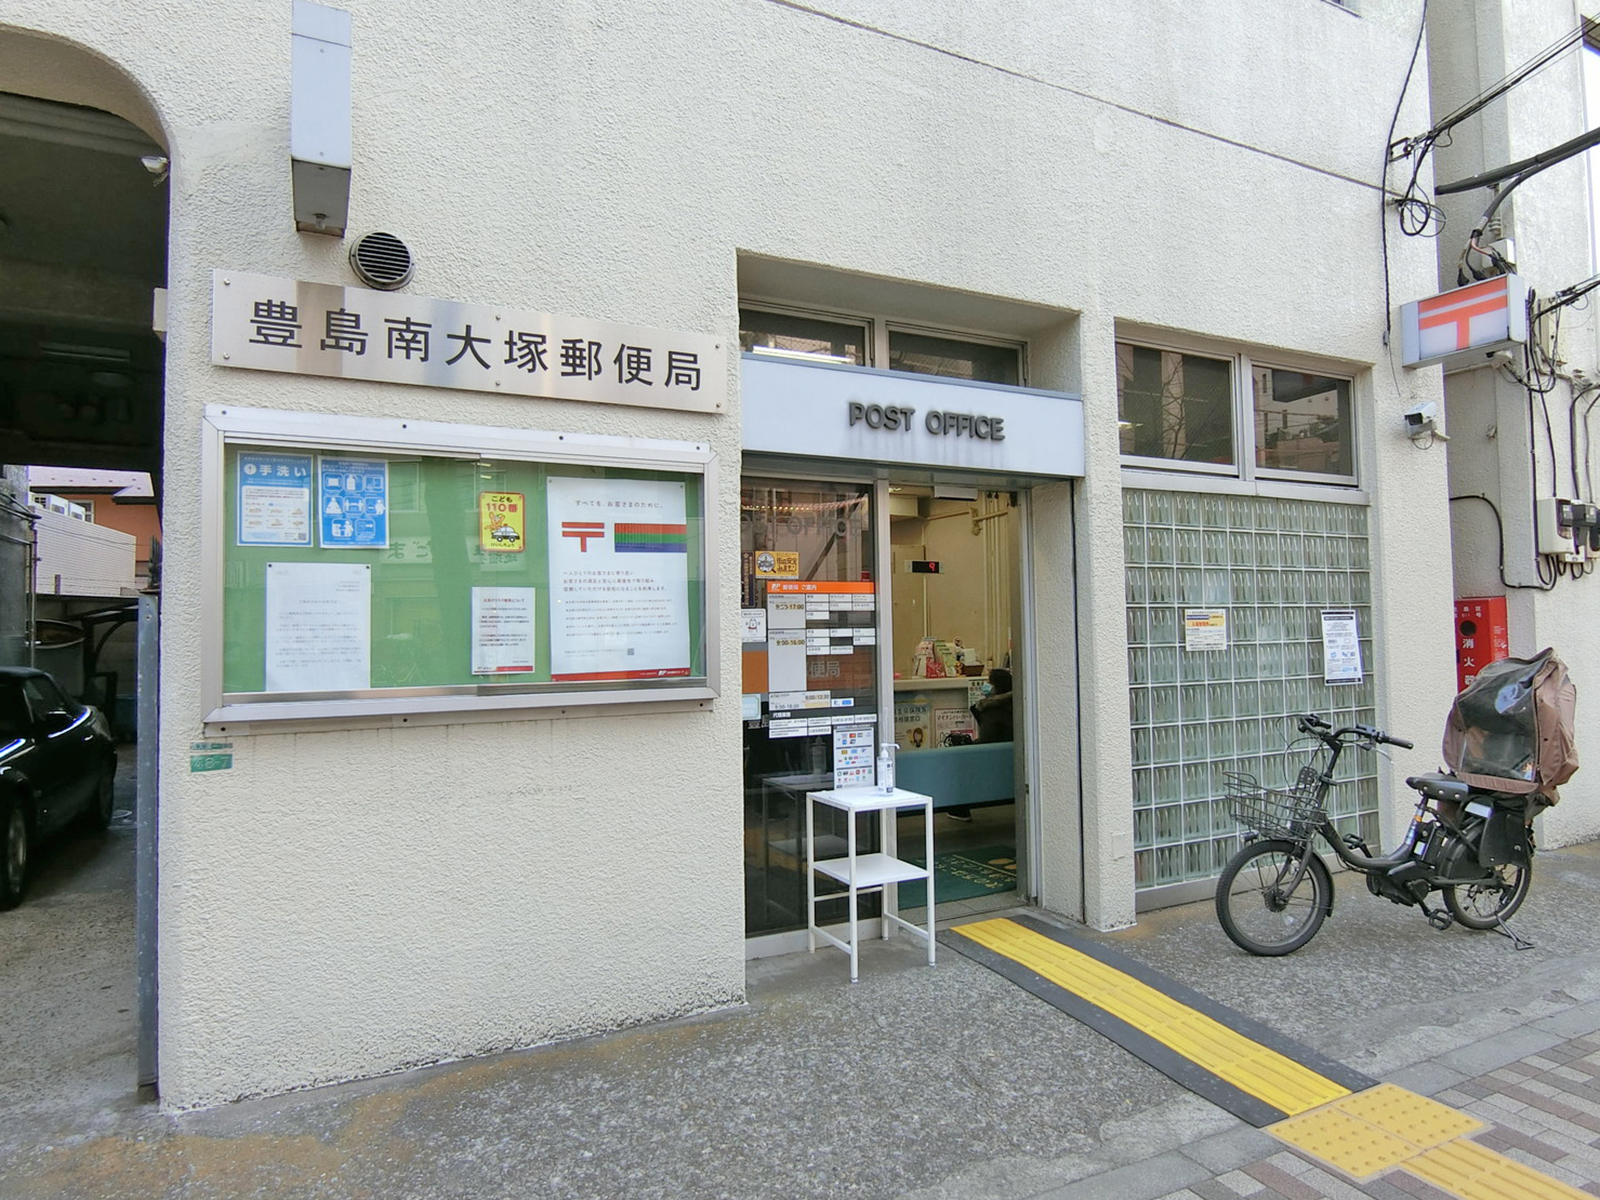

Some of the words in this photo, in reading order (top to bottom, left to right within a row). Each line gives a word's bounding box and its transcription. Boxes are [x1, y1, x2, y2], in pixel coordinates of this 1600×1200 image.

[249, 299, 702, 391] 豊島南大塚郵便局
[849, 402, 916, 432] POST
[925, 410, 1006, 441] OFFICE
[259, 463, 307, 477] 手洗い
[486, 503, 518, 513] 110番
[575, 499, 664, 509] すべてを、お客さまのために。
